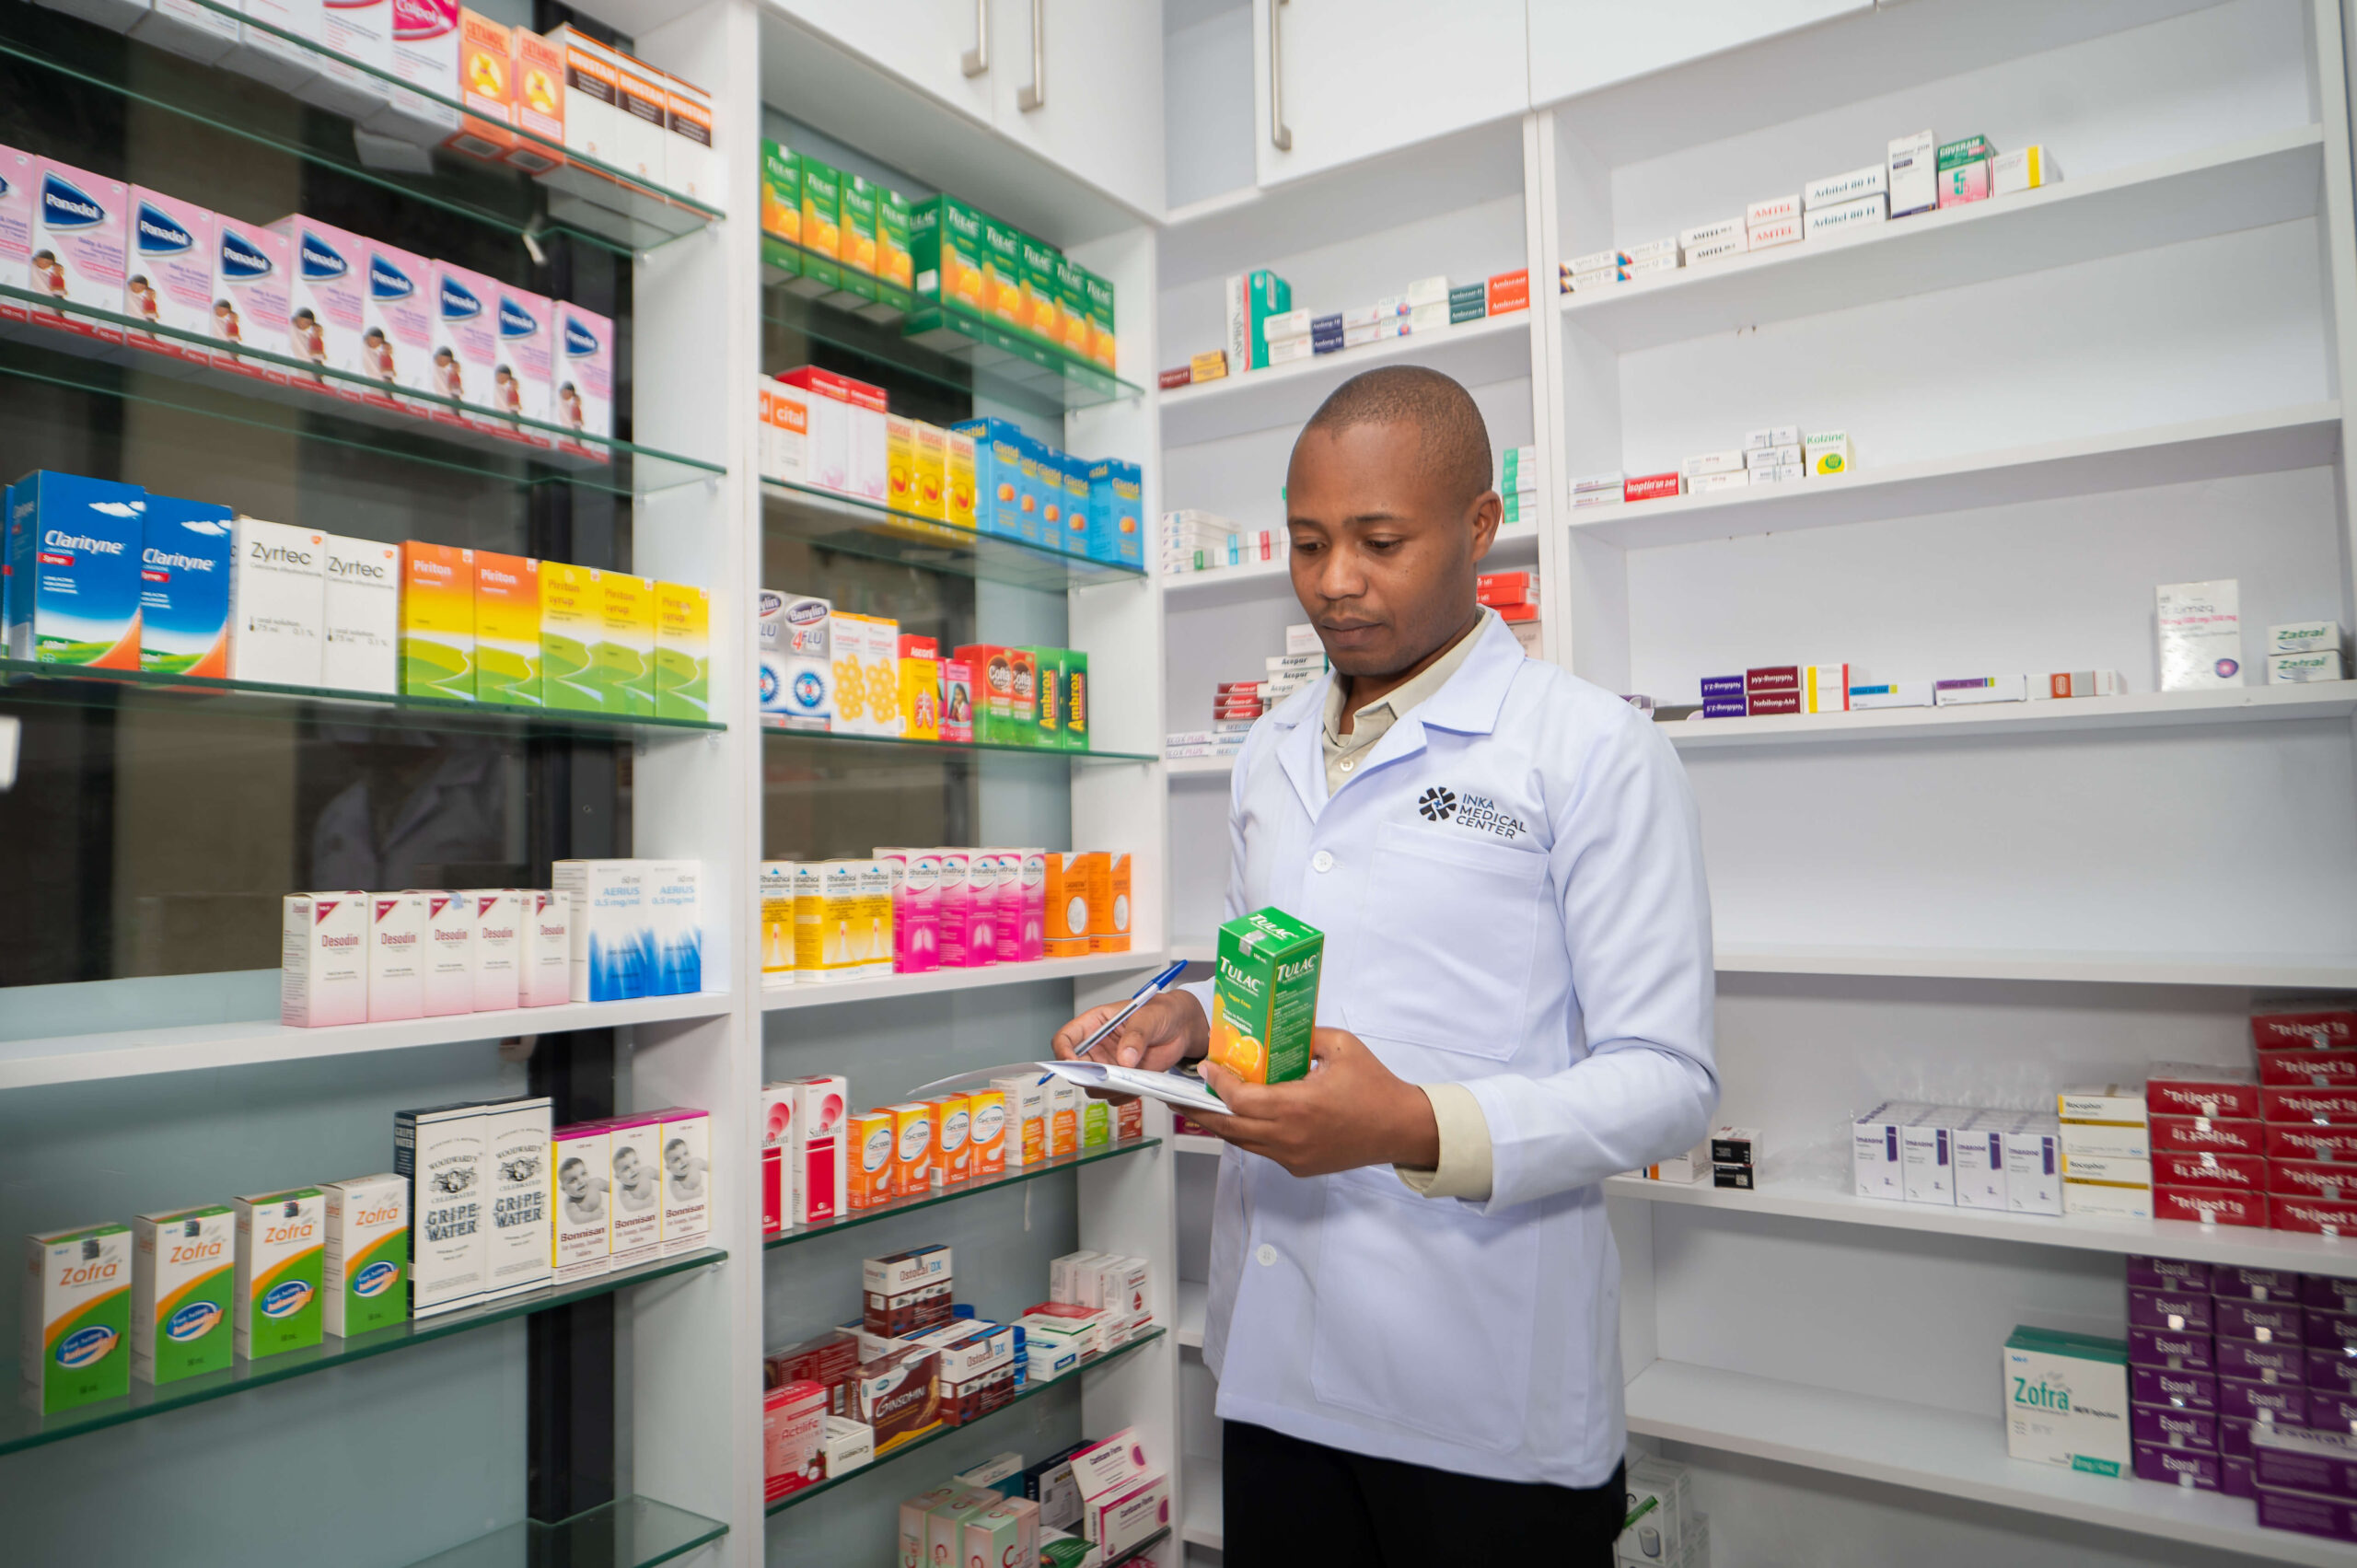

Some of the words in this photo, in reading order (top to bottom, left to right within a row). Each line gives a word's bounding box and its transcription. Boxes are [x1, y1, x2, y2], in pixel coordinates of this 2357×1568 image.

[1940, 139, 1980, 156] COVERAM
[1815, 183, 1848, 200] Arbitel
[1850, 180, 1864, 192] 80
[1866, 176, 1876, 186] H
[46, 192, 99, 219] Panadol
[1754, 204, 1793, 218] AMTEL
[948, 205, 981, 238] TULAC
[1813, 213, 1848, 229] Arbitel
[1850, 209, 1864, 222] 80
[1866, 205, 1875, 216] H
[140, 220, 187, 246] Panadol
[987, 226, 1017, 255] TULAC
[1755, 226, 1794, 242] AMTEL
[223, 247, 268, 270] Panadol
[303, 248, 343, 271] Panadol
[1024, 244, 1052, 273] TULAC
[372, 270, 411, 291] Panadol
[442, 291, 479, 311] Panadol
[1087, 280, 1112, 305] TULAC
[500, 310, 535, 331] Panadol
[565, 330, 597, 349] Panadol
[776, 407, 805, 426] cital
[1806, 433, 1845, 445] Kolzine
[993, 440, 1019, 459] Gastid
[1038, 464, 1062, 482] Gastid
[1064, 475, 1088, 490] Gastid
[1112, 478, 1139, 494] Gastid
[1665, 480, 1677, 488] 240
[44, 530, 124, 555] Clarityne
[142, 547, 214, 571] Clarityne
[251, 542, 311, 565] Zyrtec
[329, 556, 384, 578] Zyrtec
[413, 560, 452, 577] Piriton
[481, 569, 517, 585] Piriton
[548, 579, 580, 594] Piriton
[605, 588, 635, 602] Piriton
[548, 595, 575, 609] syrup
[605, 604, 630, 616] syrup
[662, 598, 691, 610] Piriton
[662, 612, 685, 624] syrup
[789, 605, 825, 621] Benylin
[2277, 628, 2326, 640] Zatral
[2278, 656, 2326, 669] Zatral
[1039, 669, 1056, 730] Ambrox
[1068, 672, 1085, 732] Ambrox
[1463, 794, 1494, 810] INKA
[1459, 805, 1527, 832] MEDICAL
[1457, 816, 1515, 840] CENTER
[604, 887, 640, 896] AERIUS
[660, 886, 694, 894] AERIUS
[611, 899, 640, 907] mg/ml
[668, 897, 695, 905] mg/ml
[435, 929, 468, 940] Desodin
[482, 927, 513, 938] Desodin
[540, 924, 564, 935] Desodin
[1248, 913, 1295, 941] TULAC
[321, 934, 359, 947] Desodin
[381, 932, 416, 945] Desodin
[1219, 956, 1261, 992] TULAC
[1277, 955, 1317, 982] TULAC
[2275, 1024, 2328, 1037] Triject
[2330, 1022, 2347, 1034] 1g
[2284, 1062, 2336, 1074] Triject
[2340, 1062, 2355, 1074] 1g
[2170, 1091, 2219, 1105] Triject
[2223, 1093, 2237, 1107] 1g
[2287, 1098, 2340, 1110] Triject
[809, 1124, 842, 1139] Saferon
[761, 1135, 788, 1149] aferon
[2290, 1135, 2342, 1148] Triject
[2292, 1170, 2343, 1186] Triject
[495, 1191, 541, 1213] GRIPE
[666, 1203, 704, 1217] Bonnisan
[2177, 1197, 2226, 1211] Triject
[2230, 1200, 2245, 1214] 1g
[355, 1207, 398, 1225] Zofra
[427, 1203, 477, 1225] GRIPE
[493, 1207, 541, 1228] WATER
[615, 1214, 656, 1228] Bonnisan
[2294, 1207, 2347, 1224] Triject
[264, 1224, 313, 1244] Zofra
[424, 1220, 477, 1242] WATER
[561, 1226, 605, 1242] Bonnisan
[170, 1242, 222, 1263] Zofra
[59, 1263, 118, 1286] Zofra
[900, 1264, 928, 1281] Ostocal
[931, 1260, 942, 1272] DX
[2154, 1260, 2189, 1277] Esoral
[2239, 1270, 2276, 1287] Esoral
[2155, 1299, 2191, 1317] Esoral
[2243, 1308, 2281, 1327] Esoral
[967, 1350, 993, 1367] Ostocal
[994, 1342, 1005, 1355] DX
[2155, 1338, 2191, 1355] Esoral
[2245, 1348, 2282, 1366] Esoral
[2014, 1377, 2069, 1411] Zofra
[2160, 1376, 2196, 1396] Esoral
[876, 1386, 926, 1417] GINSOMIN
[2247, 1389, 2285, 1408] Esoral
[783, 1419, 819, 1439] Actilife
[2160, 1416, 2196, 1434] Esoral
[2163, 1455, 2199, 1472] Esoral
